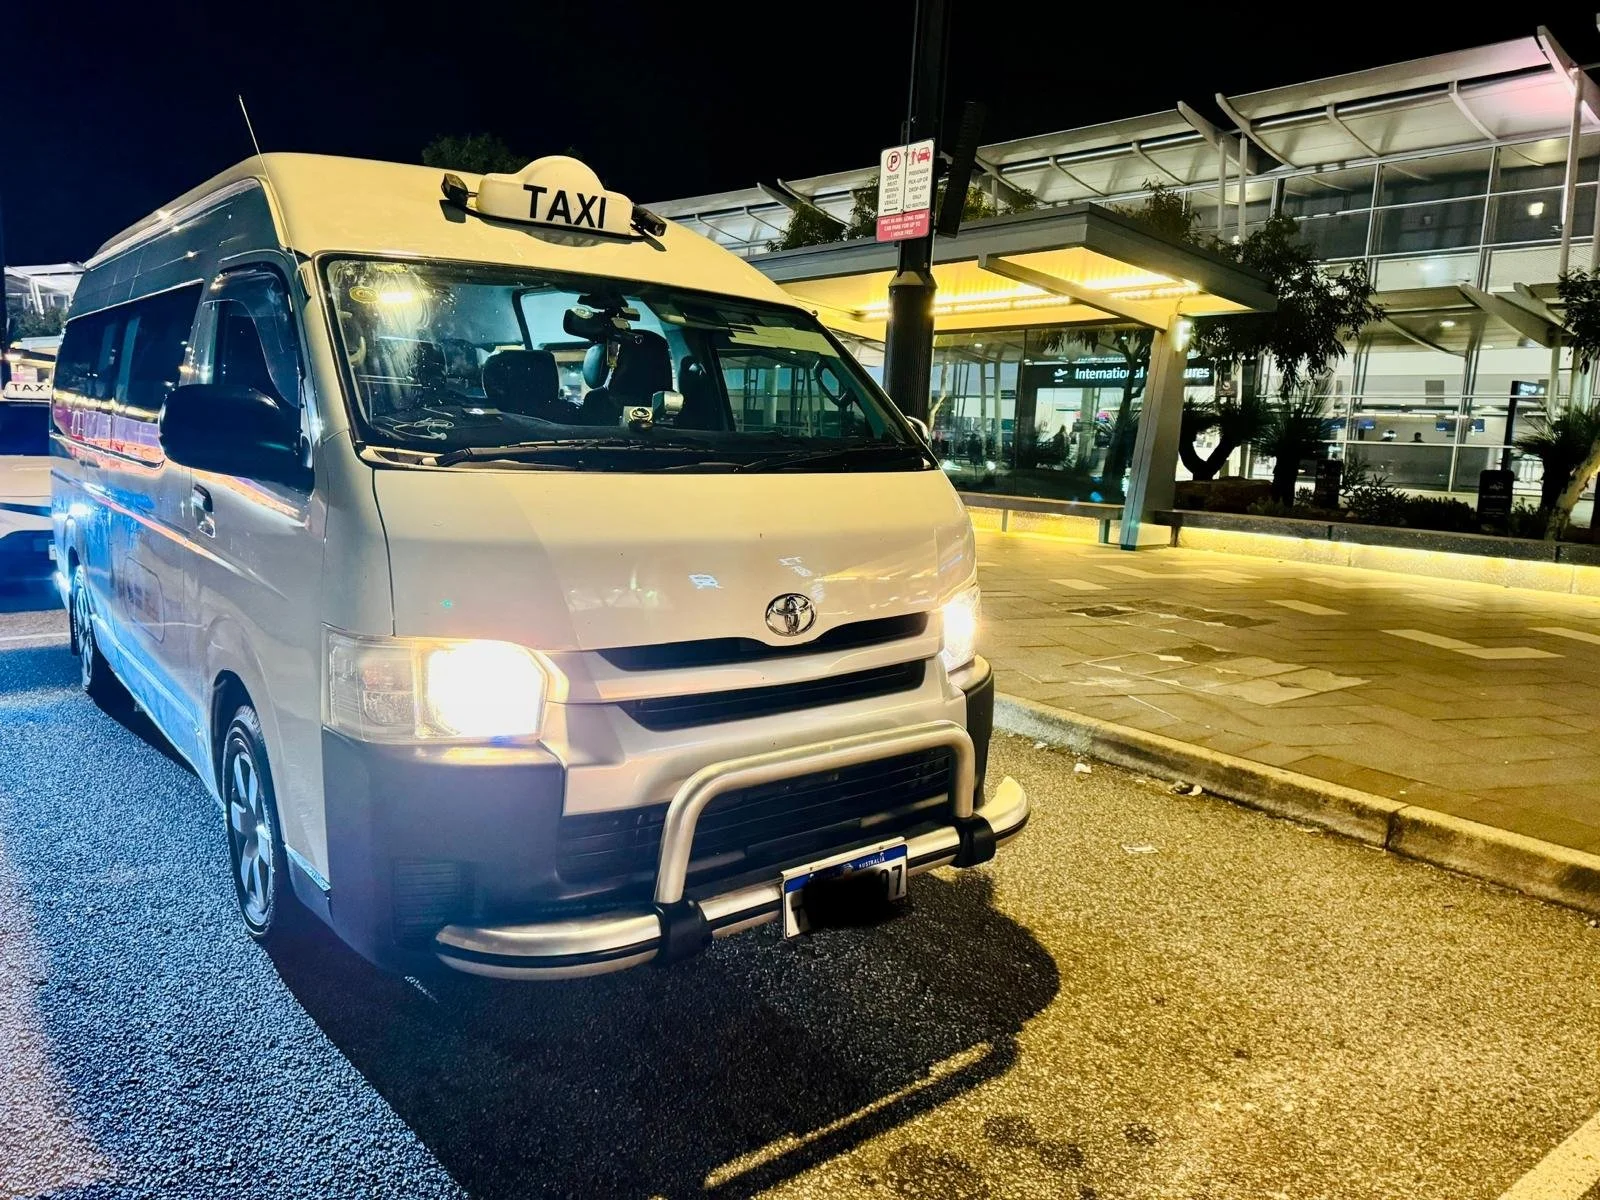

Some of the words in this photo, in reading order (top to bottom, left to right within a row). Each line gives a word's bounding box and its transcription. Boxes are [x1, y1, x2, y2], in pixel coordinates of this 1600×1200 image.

[523, 184, 607, 229] TAXI
[1075, 366, 1144, 380] Internatioal
[11, 383, 50, 392] TAX
[859, 856, 885, 868] AUSTRALIA
